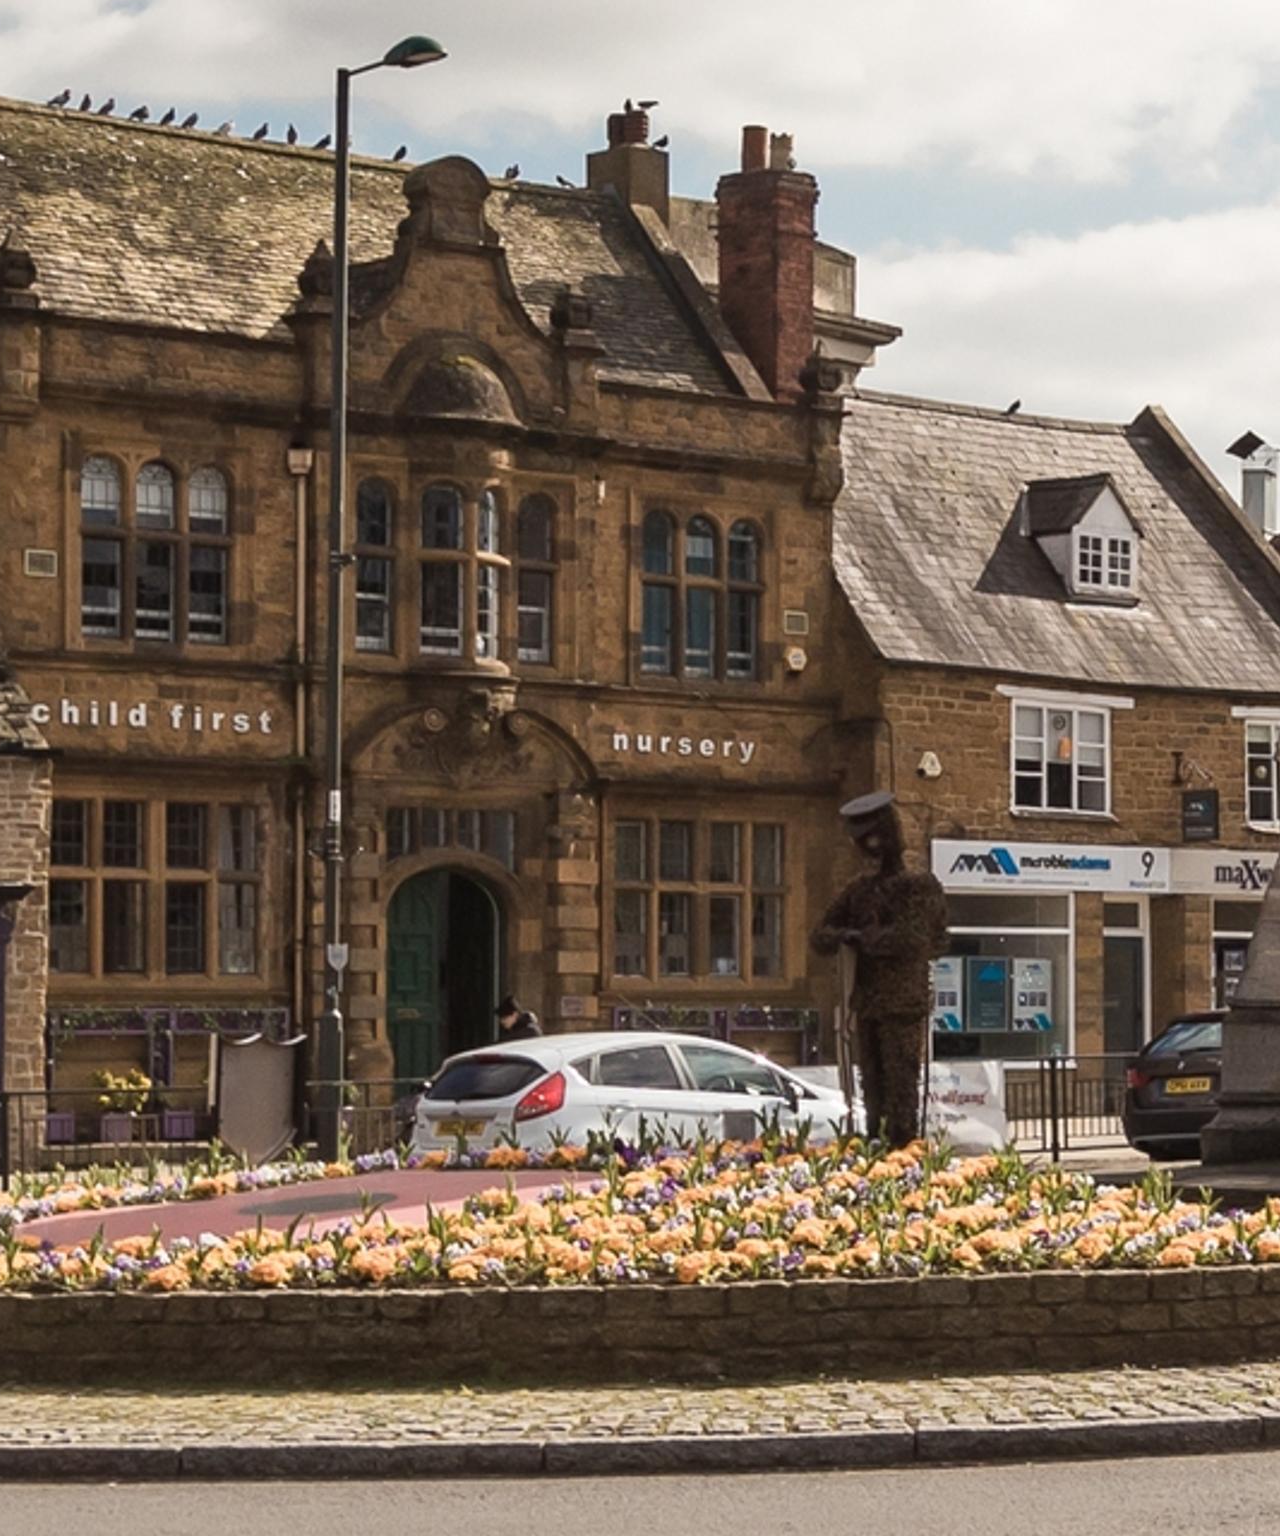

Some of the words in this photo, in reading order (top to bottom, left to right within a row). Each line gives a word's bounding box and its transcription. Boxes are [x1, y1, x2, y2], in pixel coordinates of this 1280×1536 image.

[31, 698, 147, 727] child
[170, 704, 272, 733] first
[613, 733, 755, 764] nursery
[1141, 850, 1155, 877] 9
